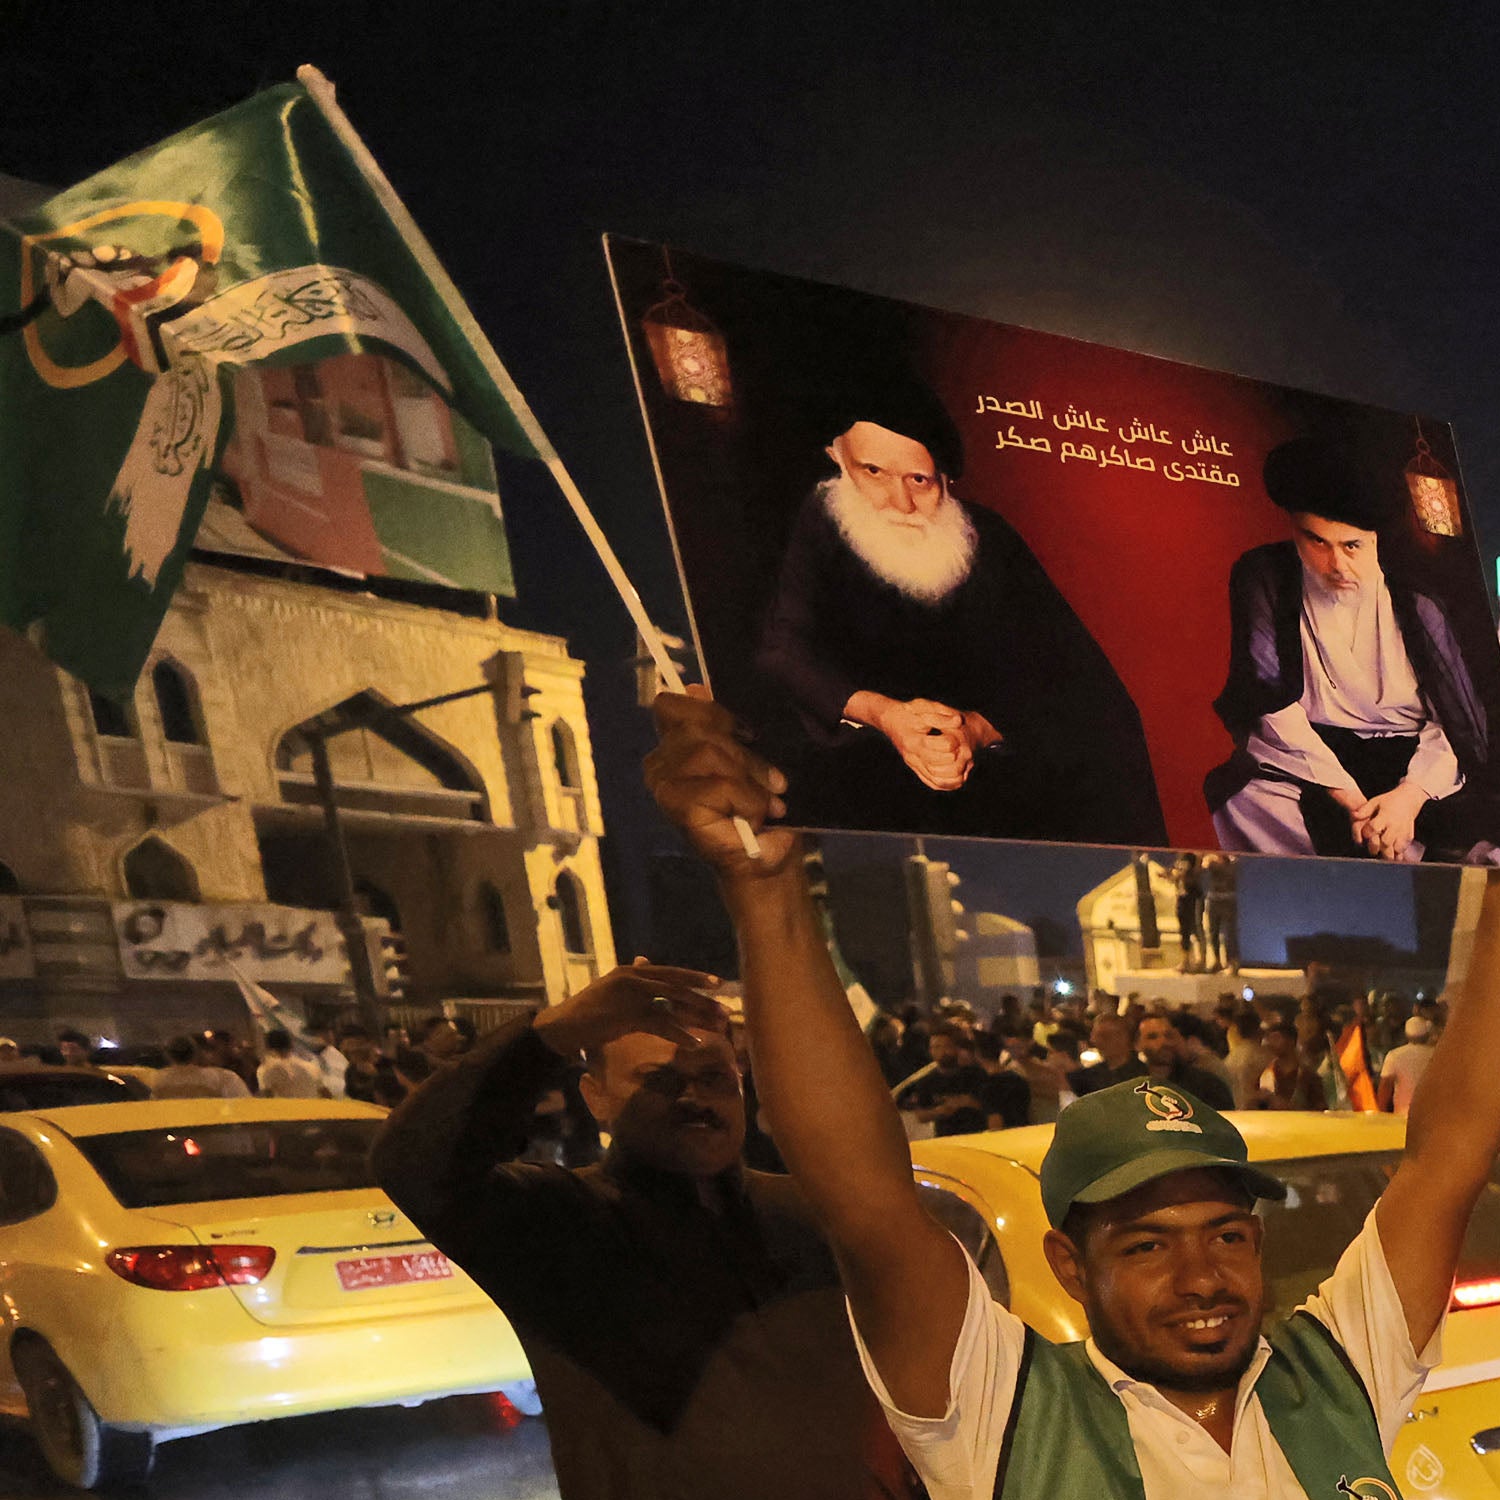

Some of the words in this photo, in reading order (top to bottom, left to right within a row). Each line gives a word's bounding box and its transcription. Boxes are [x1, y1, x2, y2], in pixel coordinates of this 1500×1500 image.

[975, 395, 1044, 420] الصدر
[1052, 404, 1110, 433] عاش
[995, 426, 1052, 453] صكر
[1118, 417, 1173, 445] عاش
[1181, 429, 1234, 457] عاش
[1163, 460, 1240, 487] مقتدى
